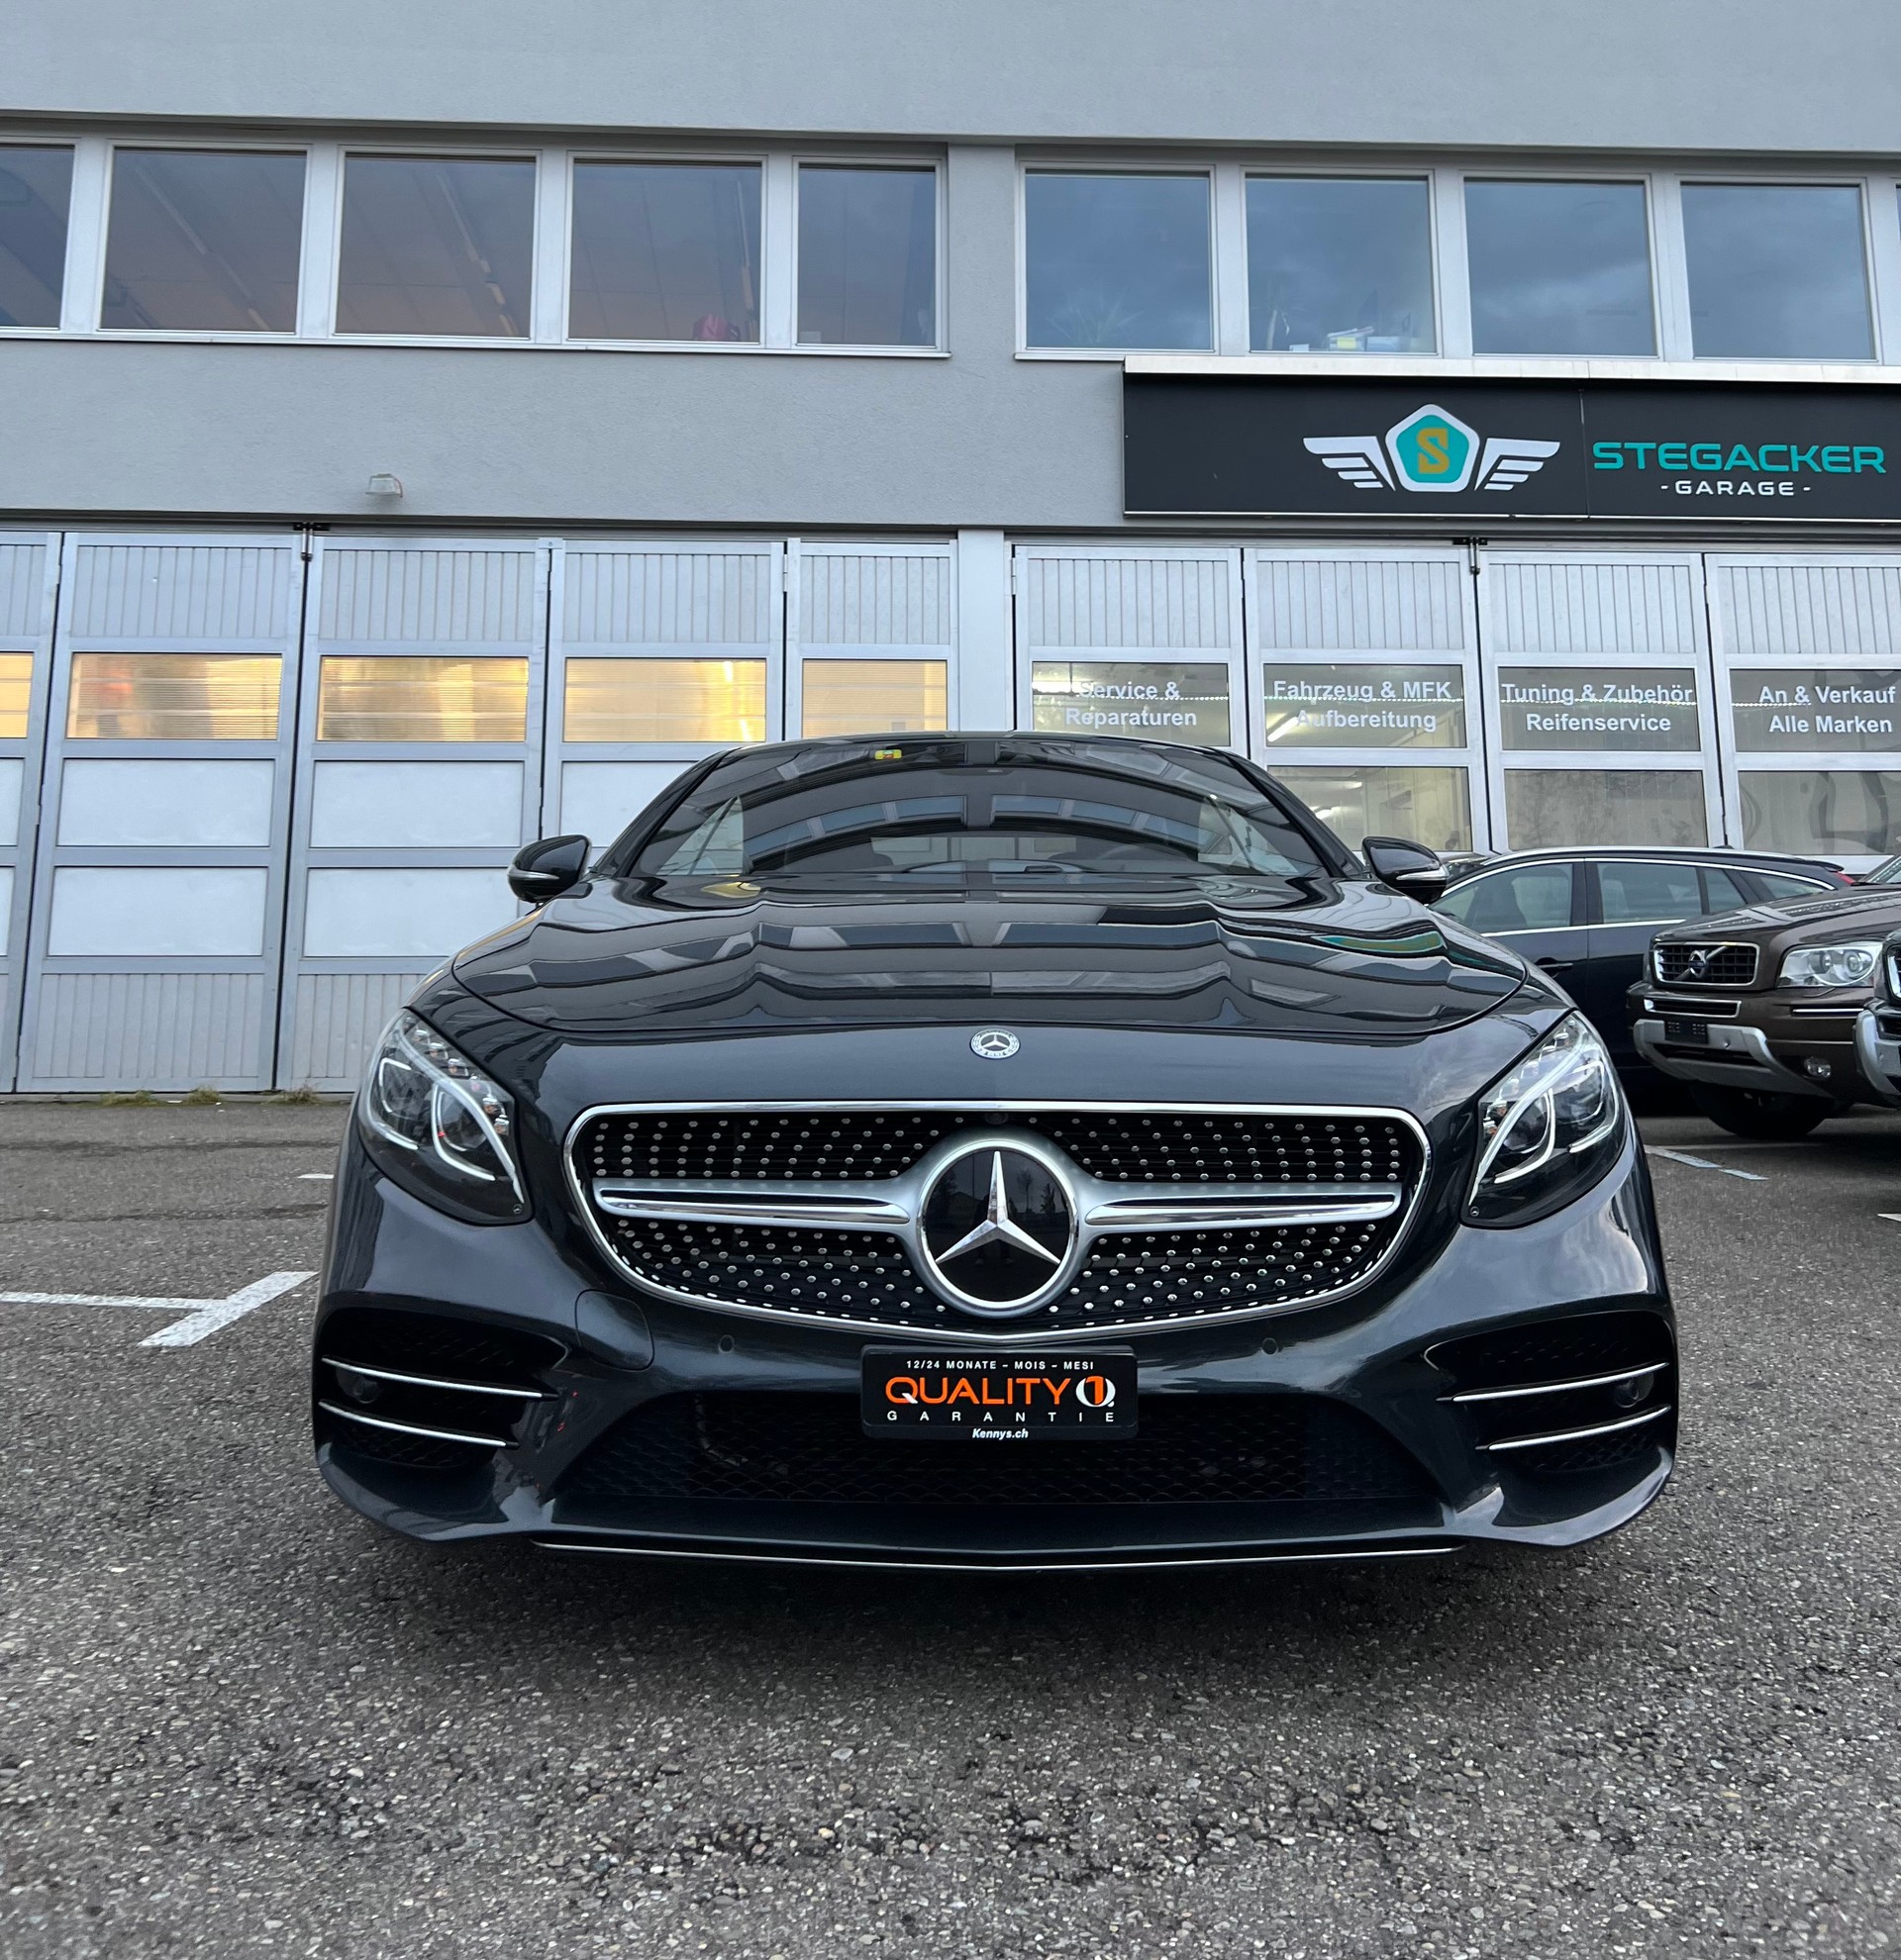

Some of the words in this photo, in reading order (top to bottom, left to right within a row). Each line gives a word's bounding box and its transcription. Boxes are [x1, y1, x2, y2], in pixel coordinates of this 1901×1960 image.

[1592, 441, 1887, 474] STEGACKER
[1079, 681, 1157, 699] Service
[1164, 681, 1180, 699] &
[1273, 680, 1373, 703] Fahrzeug
[1380, 681, 1395, 699] &
[1403, 681, 1451, 699] MFK
[1501, 683, 1574, 706] Tuning
[1581, 684, 1595, 701] &
[1603, 684, 1694, 702] Zubehör
[1758, 686, 1787, 704] An
[1794, 685, 1810, 704] &
[1815, 686, 1896, 704] Verkauf
[1065, 708, 1197, 729] Reparaturen
[1296, 710, 1437, 733] Aufbereitung
[1526, 713, 1671, 732] Reifenservice
[1768, 715, 1810, 733] Alle
[1815, 715, 1892, 734] Marken
[906, 1360, 941, 1370] 12/24
[947, 1360, 997, 1370] MONATE
[1014, 1361, 1046, 1370] MOIS
[1063, 1361, 1094, 1370] MESI
[885, 1376, 1071, 1405] QUALITY
[887, 1411, 1114, 1422] GARANTIE
[972, 1427, 1029, 1440] Kennys.ch
